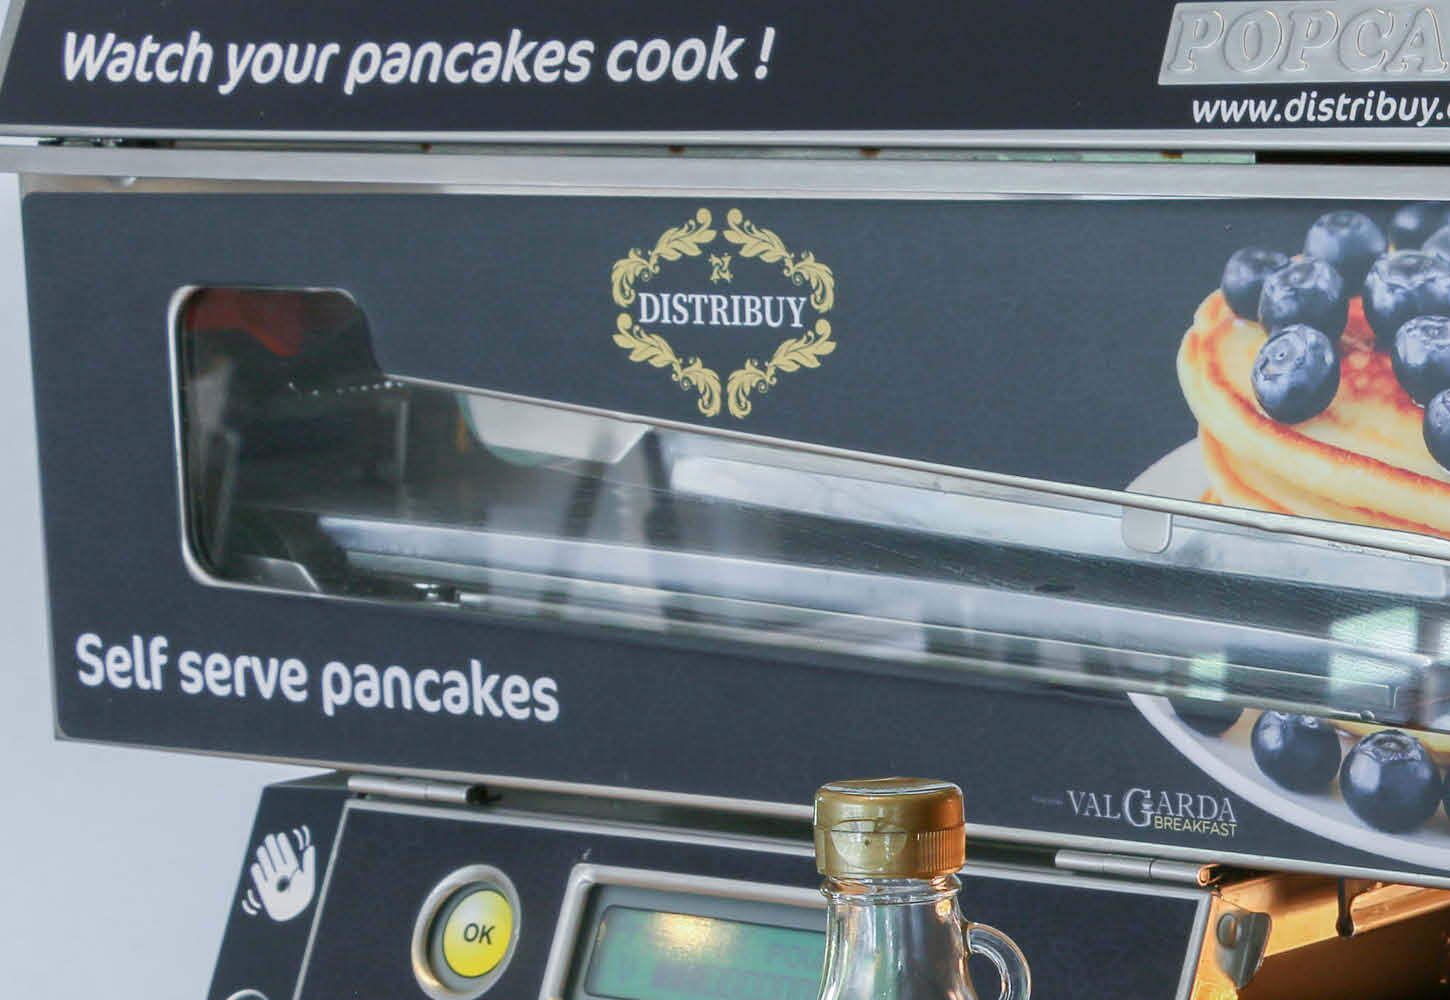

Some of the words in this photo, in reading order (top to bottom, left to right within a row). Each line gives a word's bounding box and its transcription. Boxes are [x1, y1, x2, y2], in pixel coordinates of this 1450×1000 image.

[64, 30, 214, 84] Watch
[217, 42, 341, 96] your
[343, 28, 595, 96] pancakes
[606, 24, 745, 83] cook
[754, 26, 776, 80] !
[638, 292, 808, 328] DISTRIBUY
[75, 632, 169, 691] Self
[178, 650, 308, 703] serve
[321, 658, 560, 723] pancakes
[1154, 816, 1237, 837] BREAKFAST
[463, 922, 496, 945] OK
